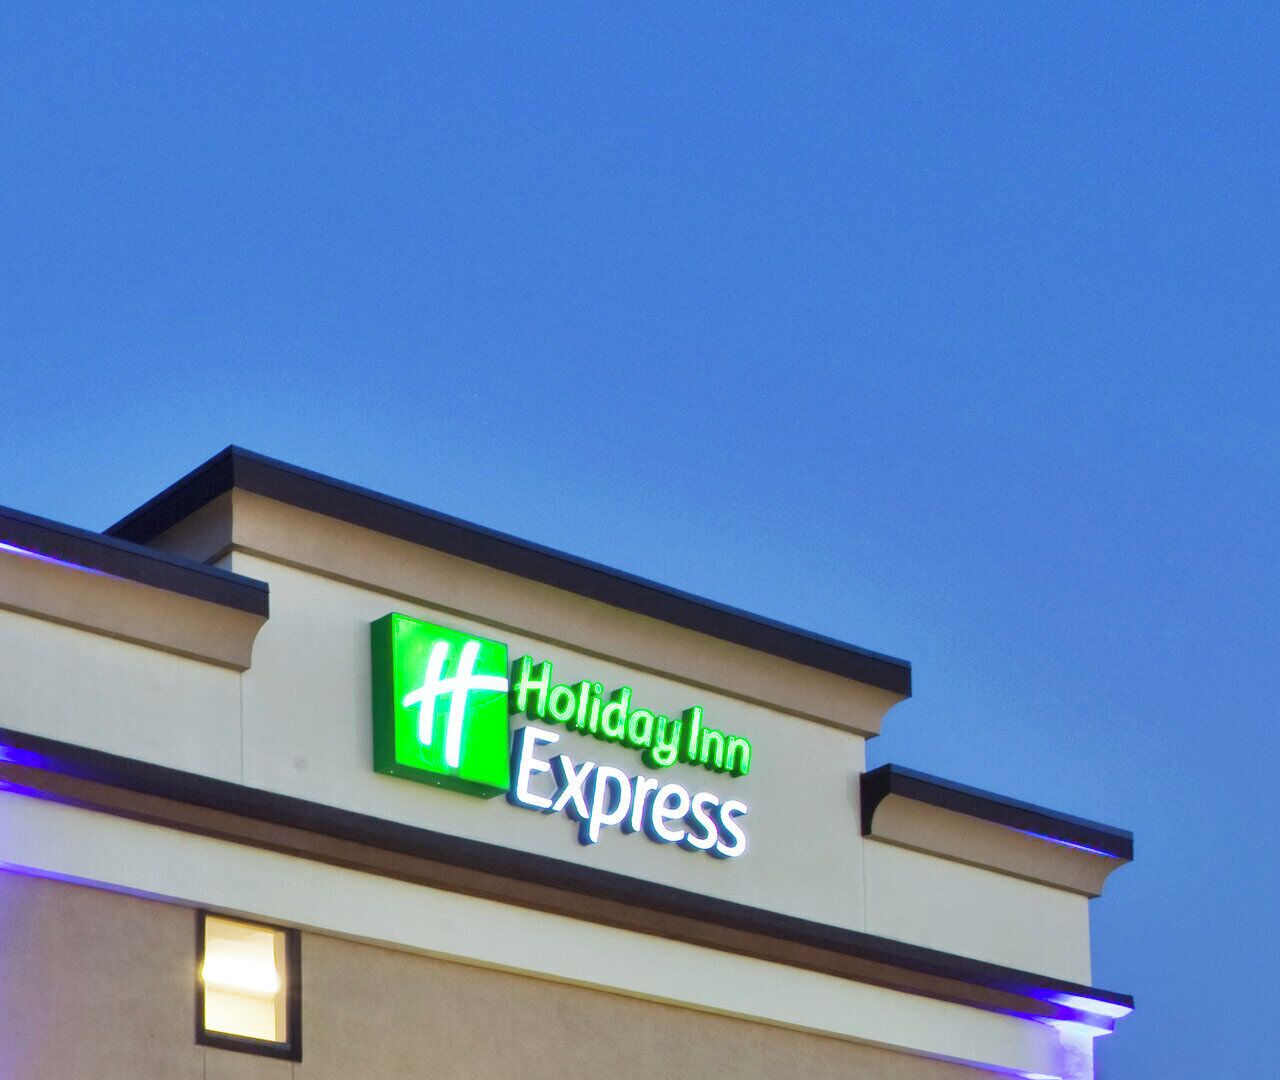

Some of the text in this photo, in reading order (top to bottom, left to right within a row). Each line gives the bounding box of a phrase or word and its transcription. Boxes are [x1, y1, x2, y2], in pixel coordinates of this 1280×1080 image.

[512, 654, 752, 777] Holiday Inn
[510, 724, 749, 859] Express
